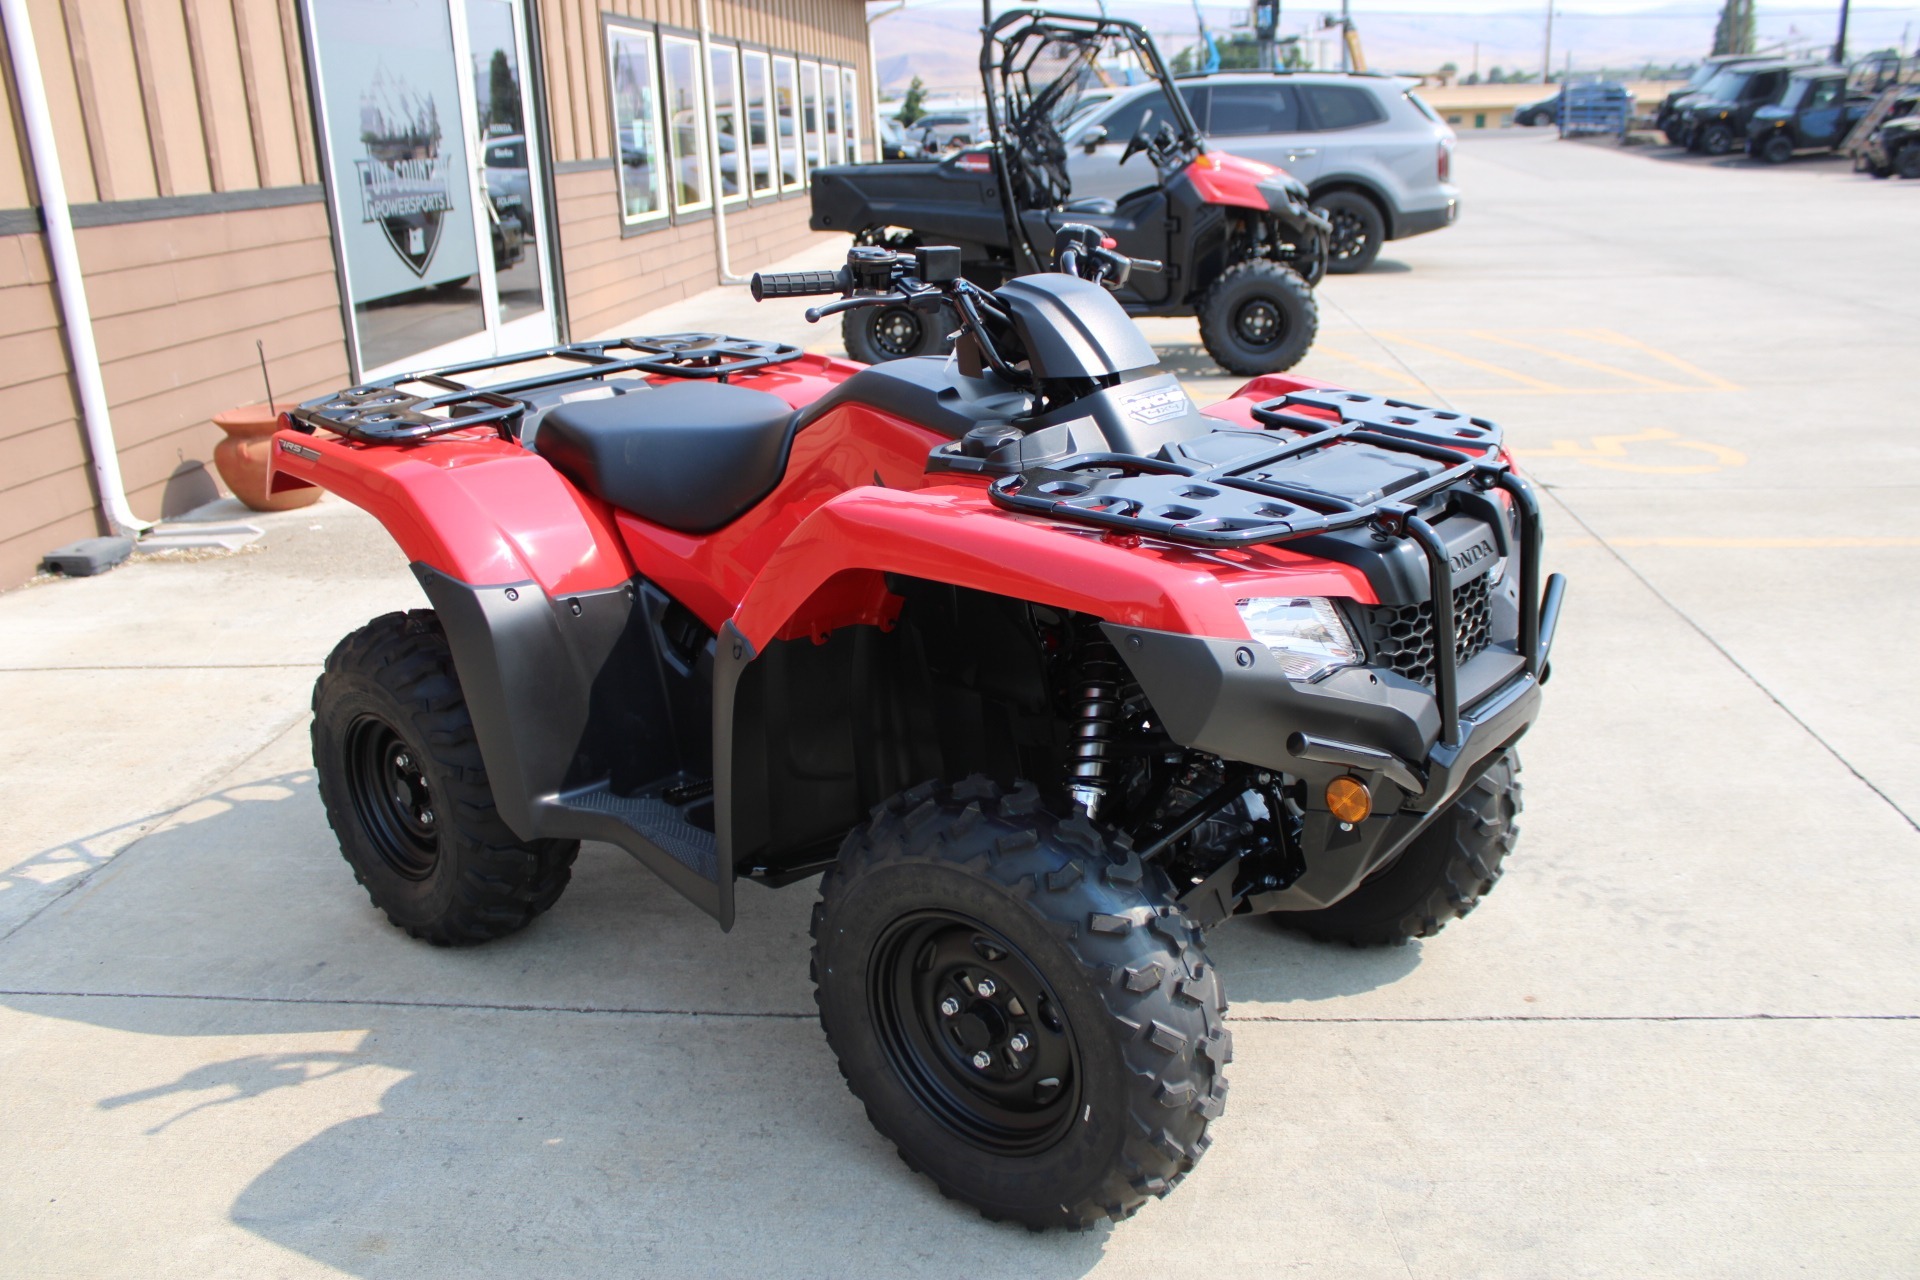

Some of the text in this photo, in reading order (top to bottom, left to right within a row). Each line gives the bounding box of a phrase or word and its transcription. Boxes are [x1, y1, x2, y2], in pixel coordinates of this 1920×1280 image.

[353, 157, 391, 224] FUN
[373, 193, 445, 219] POWERSPORTS
[282, 440, 301, 452] IRS
[1450, 540, 1494, 573] ONDA
